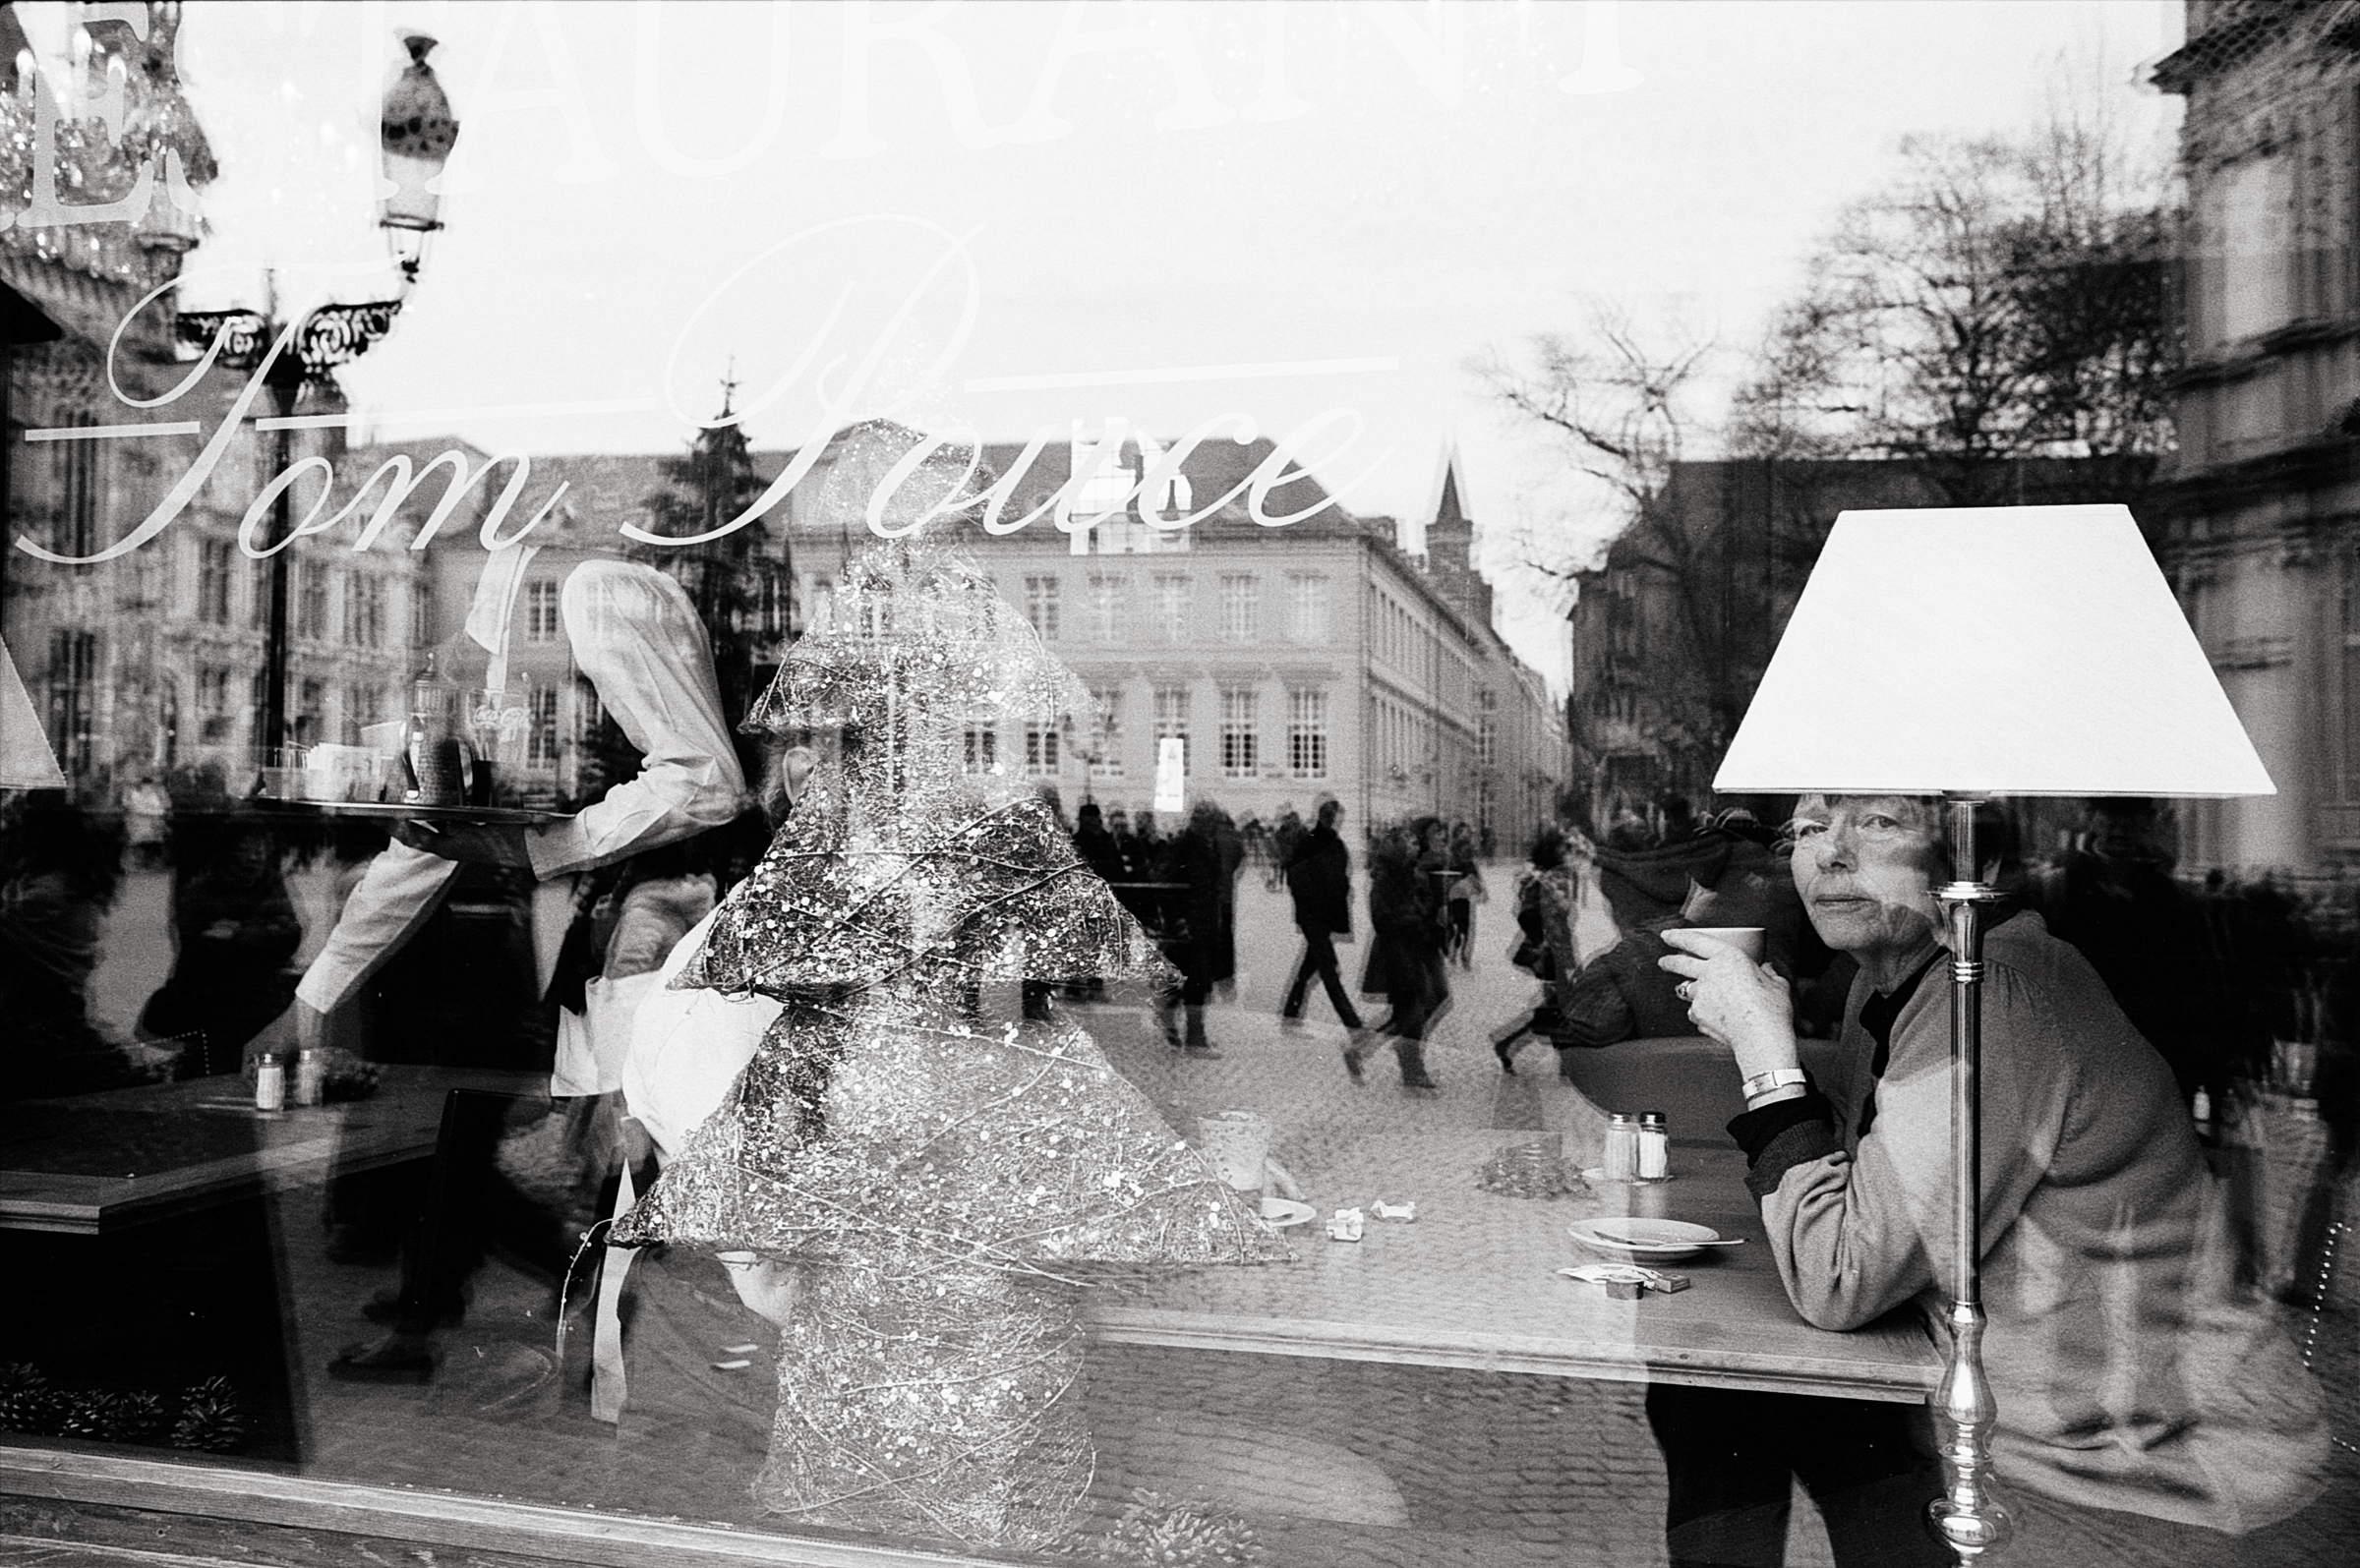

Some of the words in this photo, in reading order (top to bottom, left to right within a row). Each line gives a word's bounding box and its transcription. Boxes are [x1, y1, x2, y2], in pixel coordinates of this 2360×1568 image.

[0, 0, 1646, 229] ESTAURA
[15, 251, 570, 563] Tom
[619, 212, 1394, 547] Pouce
